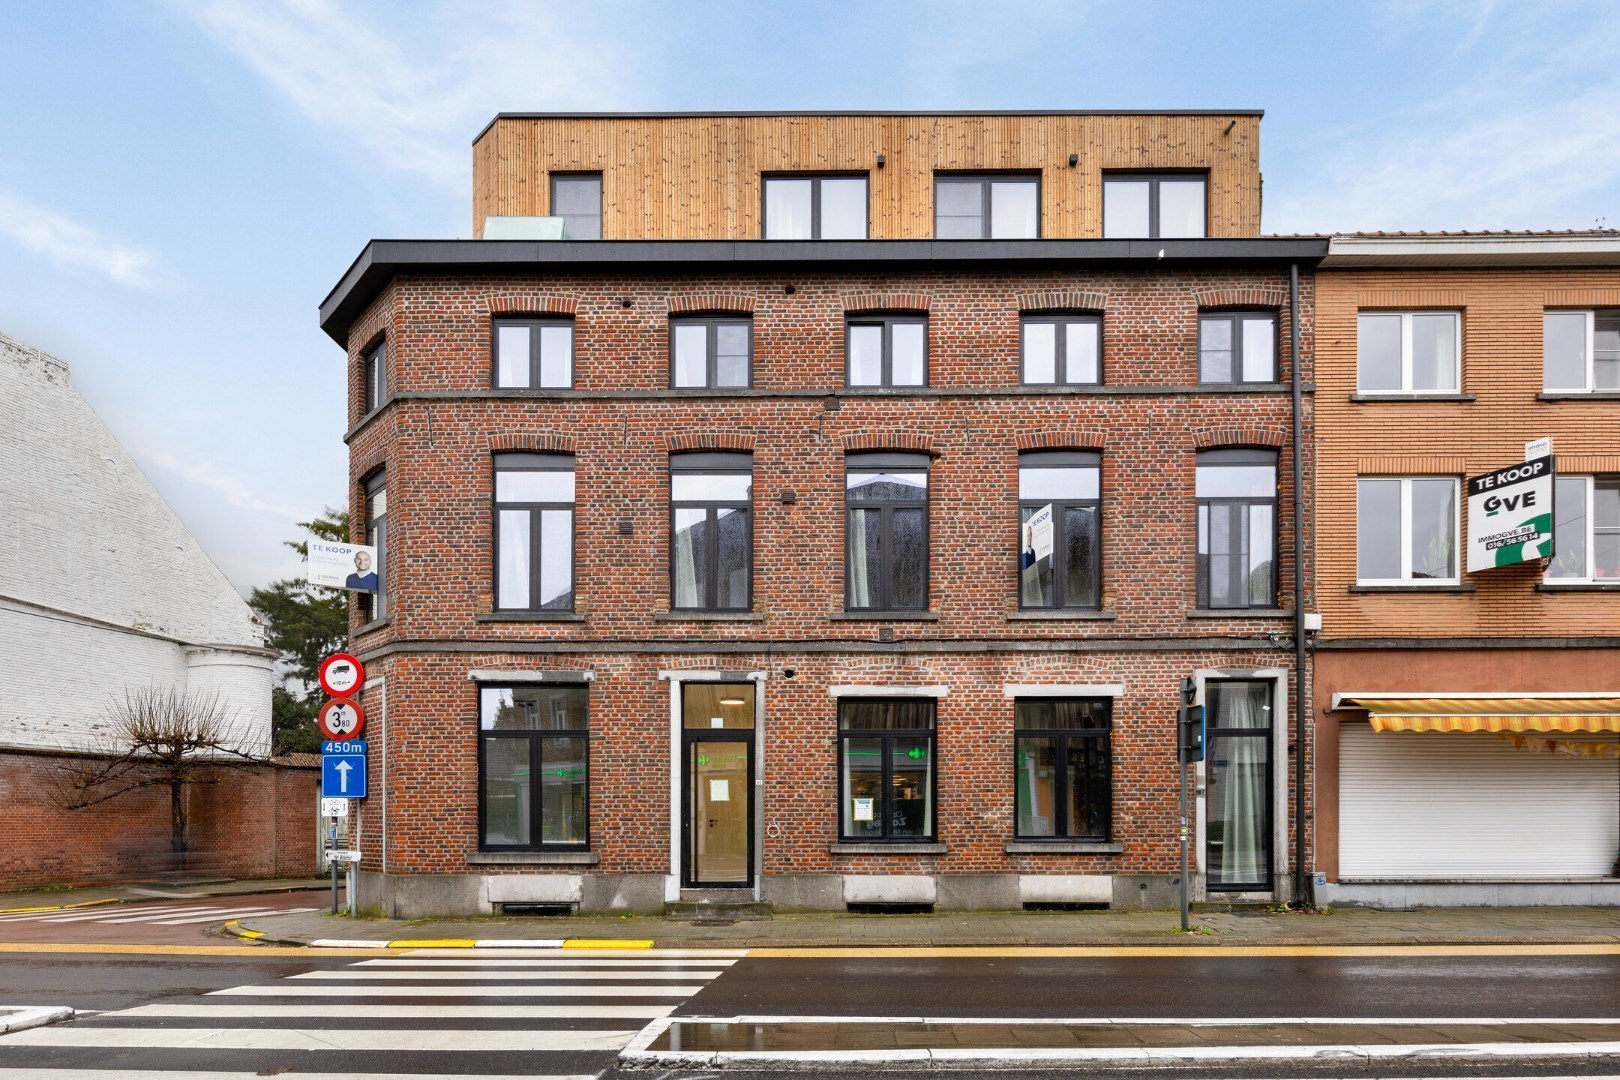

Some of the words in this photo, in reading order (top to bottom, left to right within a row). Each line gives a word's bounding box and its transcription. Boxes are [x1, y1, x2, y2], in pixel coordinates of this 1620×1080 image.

[1476, 476, 1494, 490] TE
[1497, 462, 1543, 485] KOOP
[1483, 490, 1536, 512] GVE
[1478, 526, 1532, 543] IMMOGVE.BE
[326, 546, 352, 554] KOOP
[332, 712, 341, 728] 3
[341, 720, 350, 728] 80
[325, 742, 362, 753] 450m
